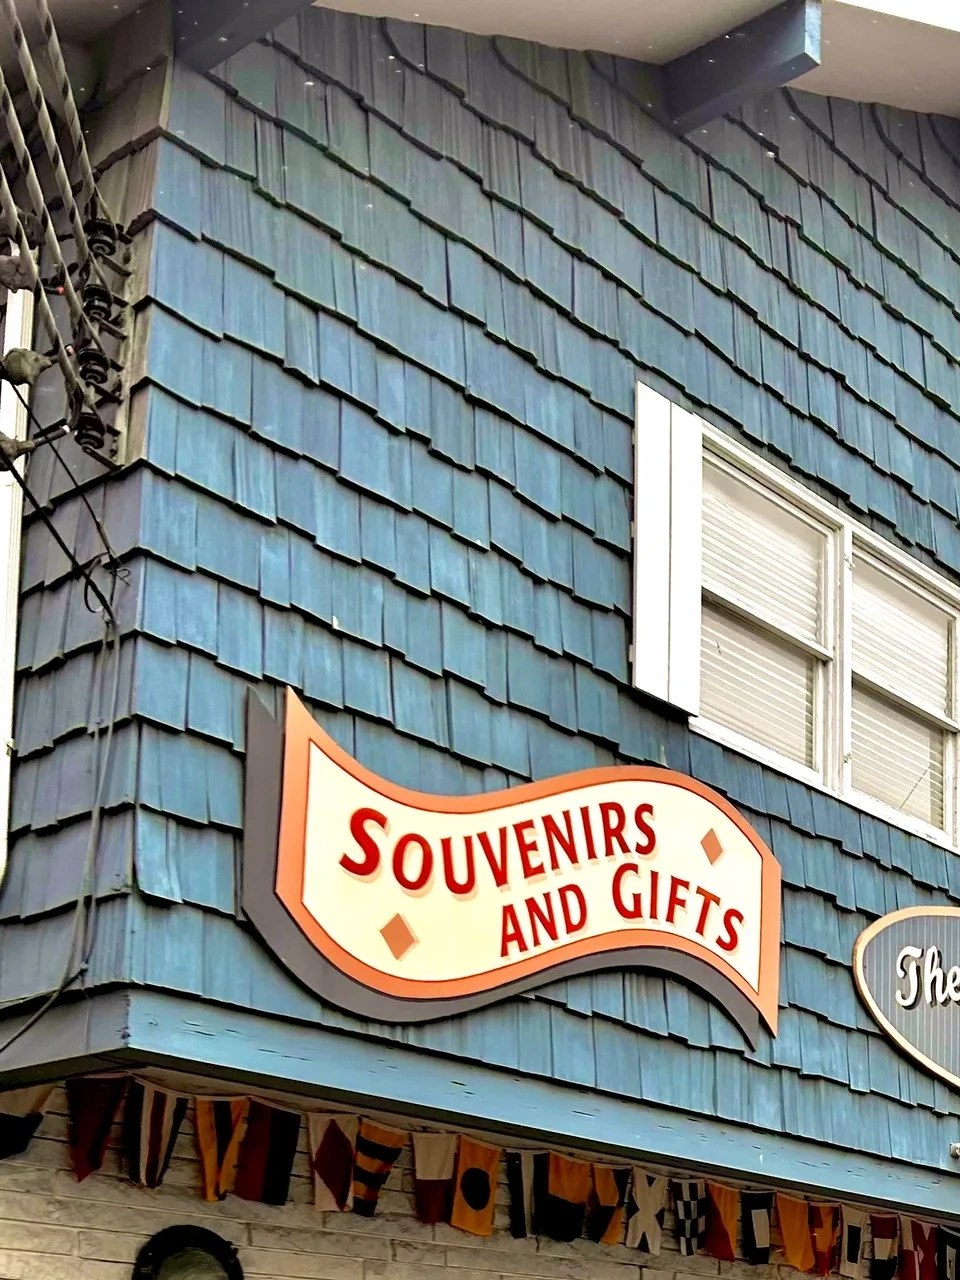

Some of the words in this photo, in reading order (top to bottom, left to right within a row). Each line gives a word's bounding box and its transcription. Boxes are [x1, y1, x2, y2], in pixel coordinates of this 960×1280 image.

[339, 801, 657, 895] SOUVENIRS
[499, 883, 588, 958] AND
[611, 862, 745, 952] GIFTS
